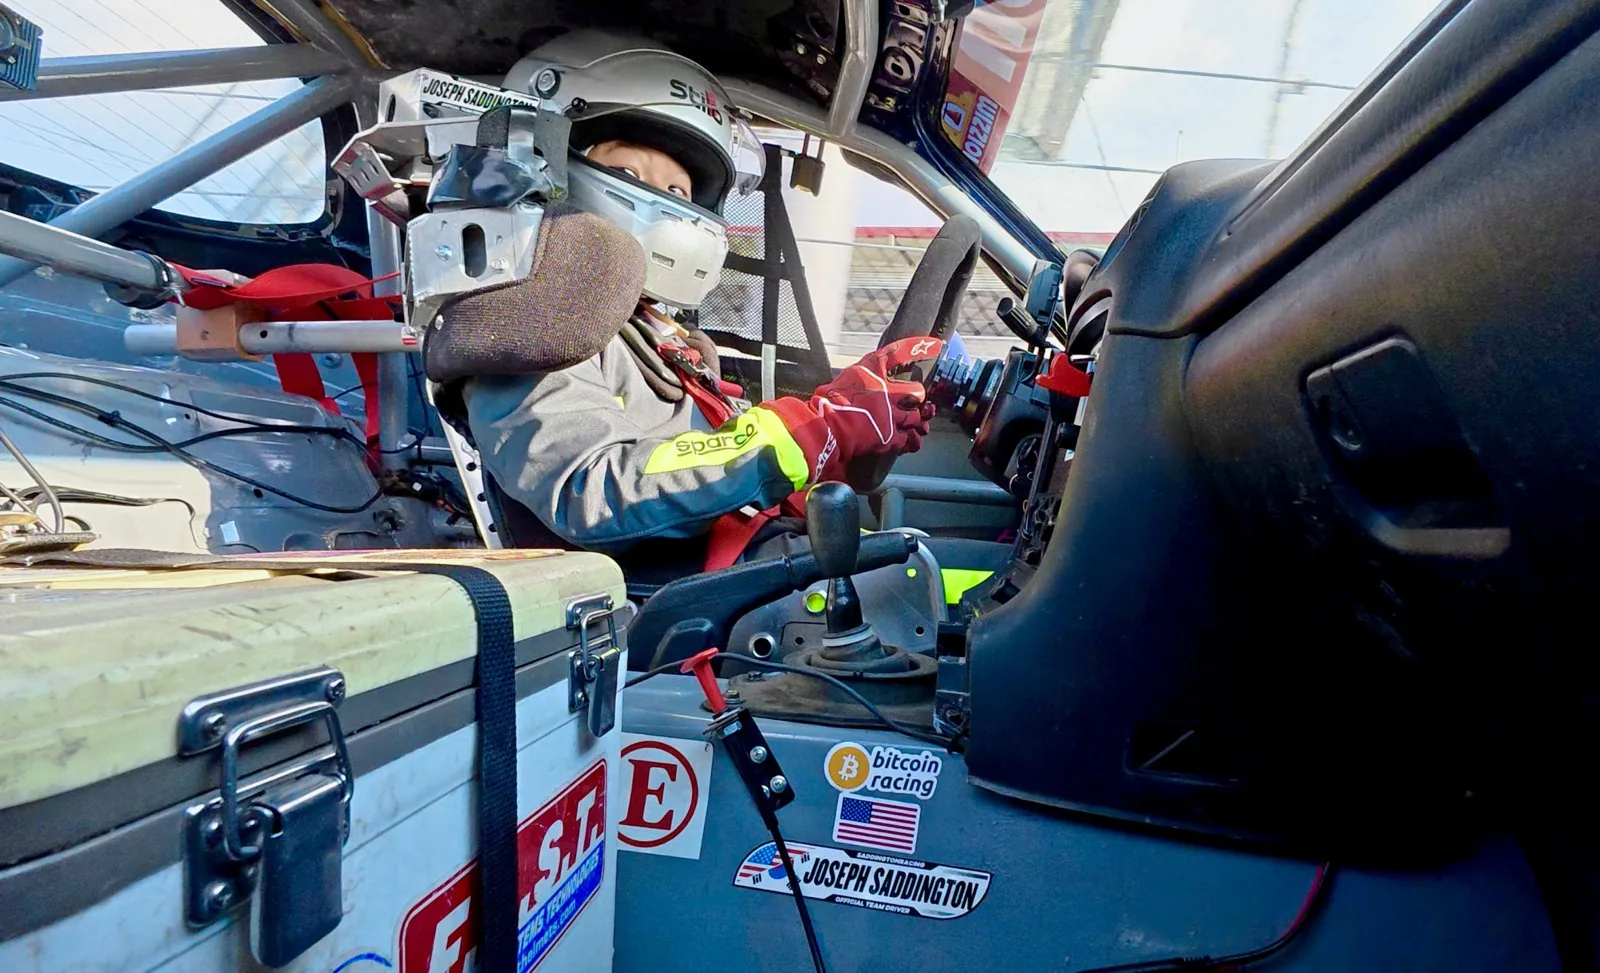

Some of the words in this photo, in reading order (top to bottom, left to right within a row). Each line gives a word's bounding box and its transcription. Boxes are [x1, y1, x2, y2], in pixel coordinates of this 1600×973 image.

[423, 78, 467, 103] JOSEPH
[669, 79, 723, 125] Stilo
[675, 423, 757, 456] sparco
[872, 750, 940, 774] bitcoin
[619, 758, 679, 831] E
[871, 772, 935, 797] racing
[803, 857, 872, 893] JOSEPH
[868, 867, 980, 911] SADDINGTON
[835, 896, 865, 907] OFFICIAL
[865, 900, 885, 911] TEAM
[884, 903, 911, 915] DRIVER
